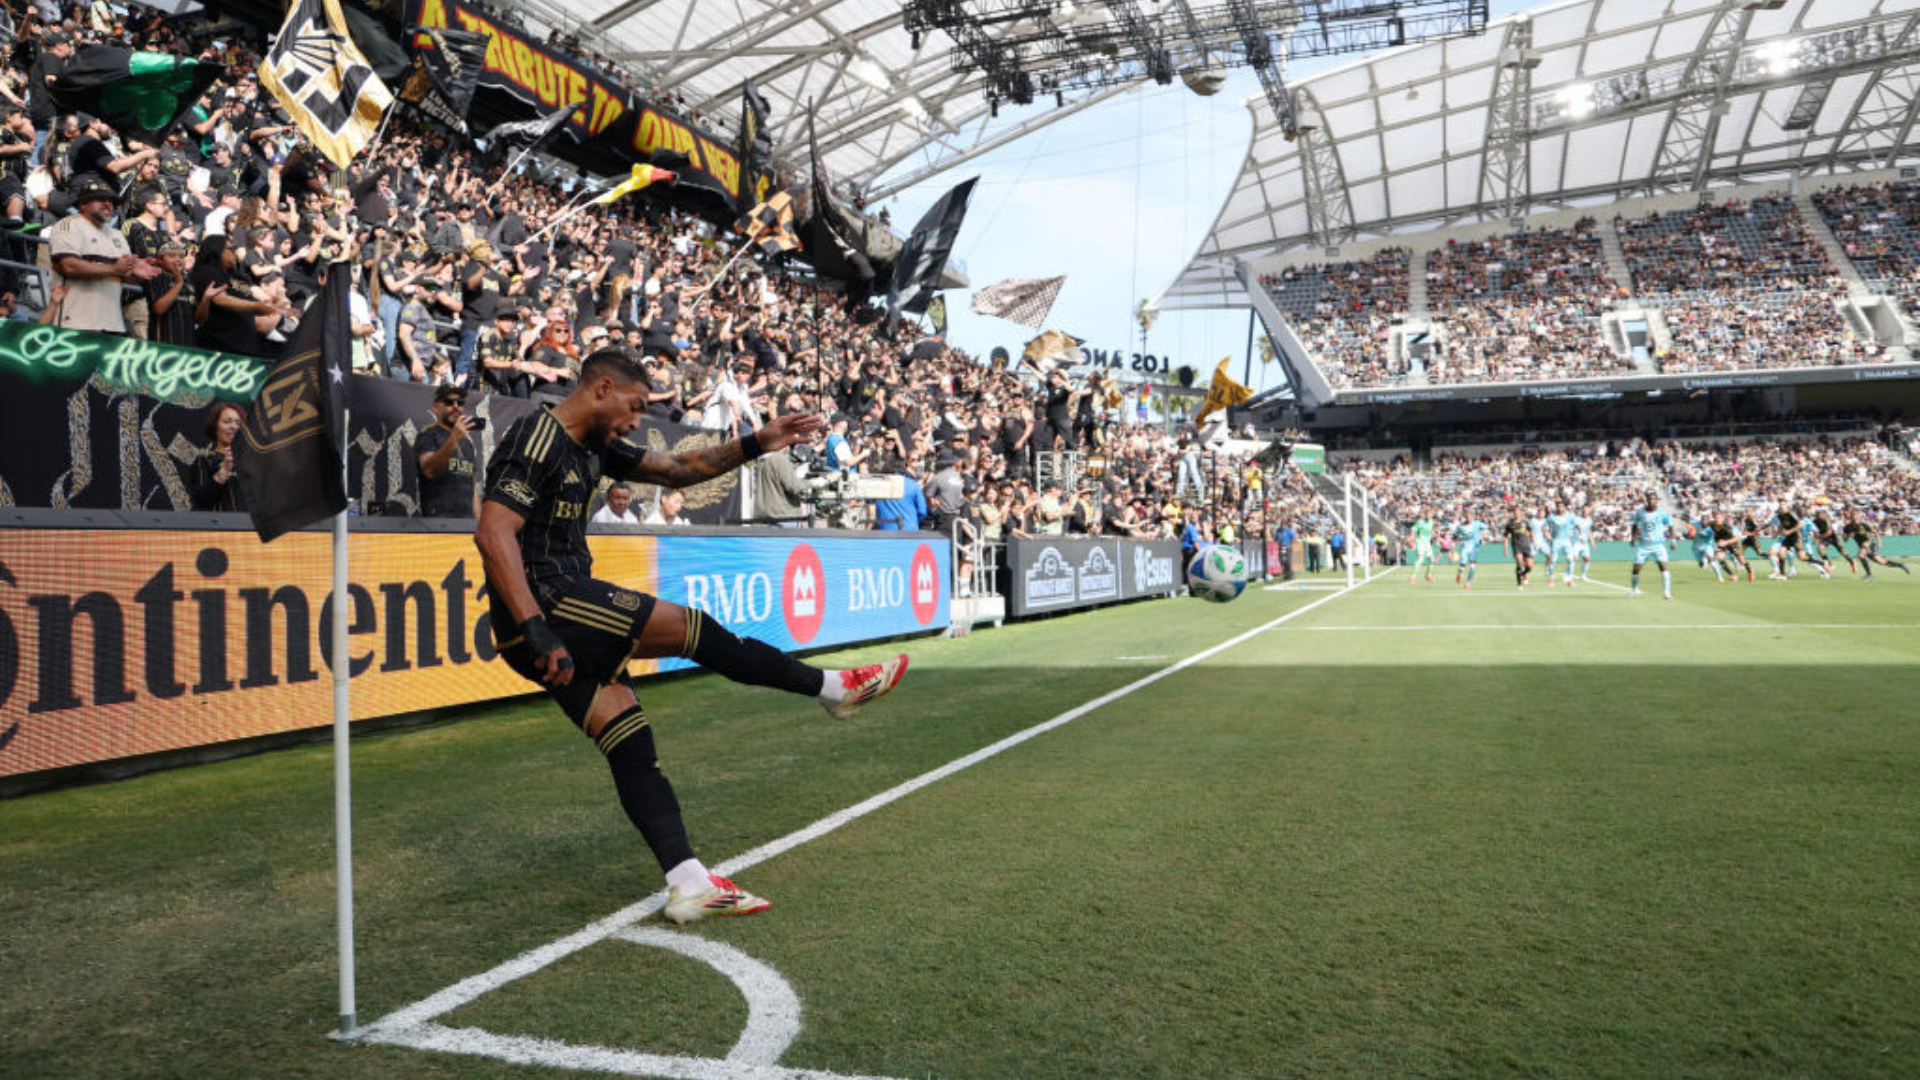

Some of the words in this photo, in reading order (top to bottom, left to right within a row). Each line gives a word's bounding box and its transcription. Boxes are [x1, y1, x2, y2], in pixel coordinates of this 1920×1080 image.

[455, 6, 588, 125] TRIBUTE
[588, 80, 624, 137] TO
[632, 108, 703, 169] OUR
[103, 338, 265, 397] Angeles
[684, 572, 772, 624] BMO
[847, 566, 904, 611] BMO
